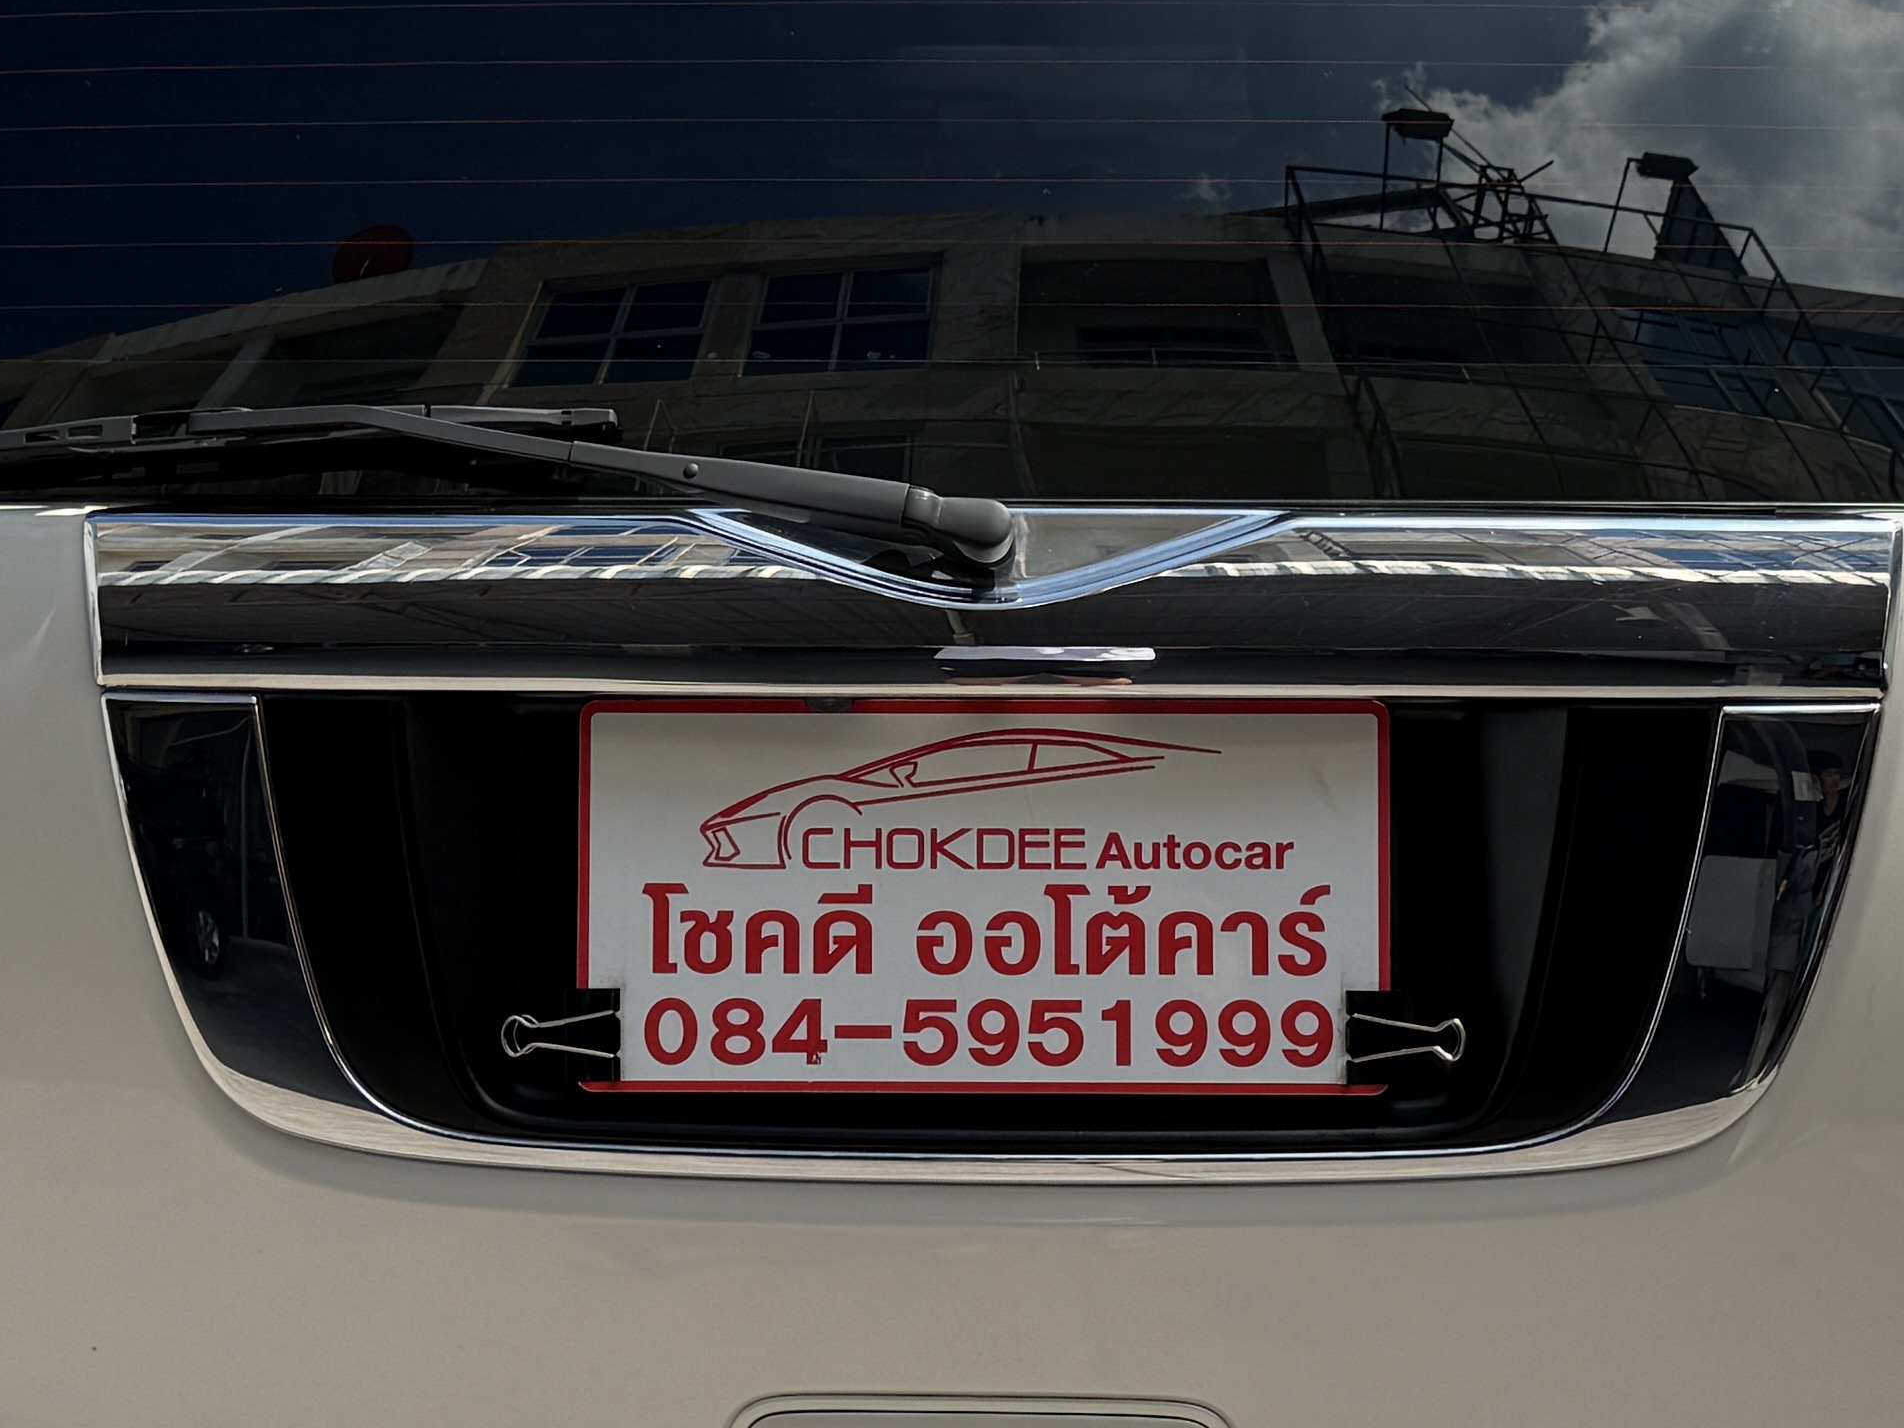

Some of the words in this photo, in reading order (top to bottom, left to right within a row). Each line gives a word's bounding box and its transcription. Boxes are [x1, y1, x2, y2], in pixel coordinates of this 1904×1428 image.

[800, 828, 1088, 871] CHOKDEE
[1097, 831, 1295, 871] Autocar
[642, 883, 874, 977] โชคดี
[917, 883, 1333, 977] ออโต้คาร์
[643, 997, 1332, 1069] 084-5951999
